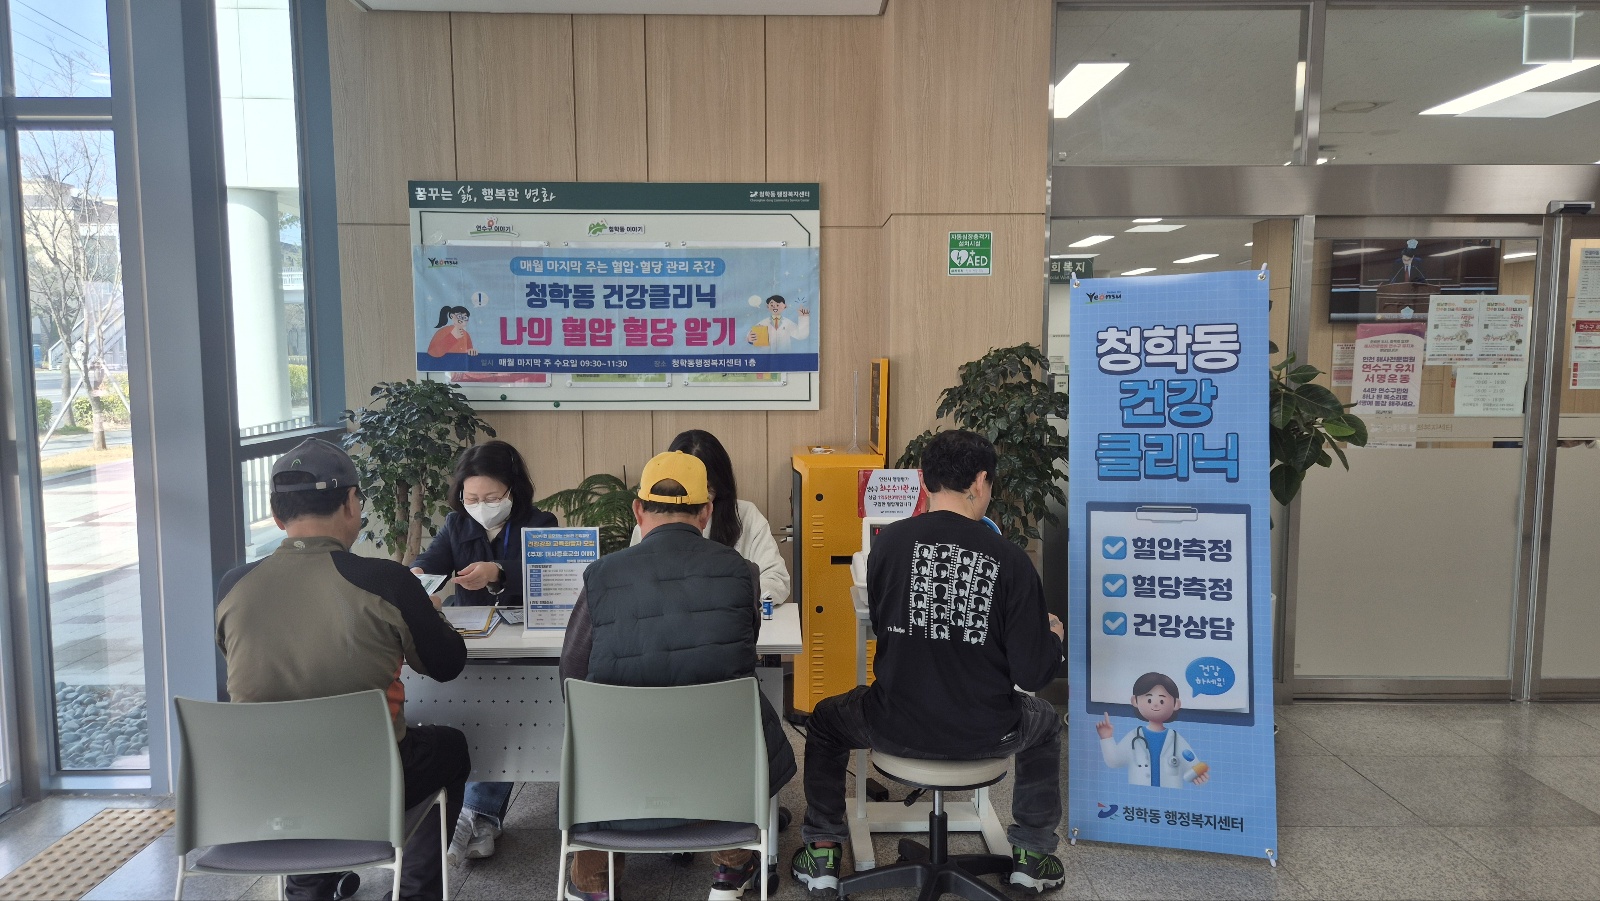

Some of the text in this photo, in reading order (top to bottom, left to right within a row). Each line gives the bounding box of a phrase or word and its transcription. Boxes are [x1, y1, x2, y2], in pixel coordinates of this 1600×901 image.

[415, 185, 557, 203] 꿈꾸는 삶, 행복한 변화
[475, 224, 493, 233] 연수구
[428, 257, 458, 267] Yeonsu
[519, 259, 715, 274] 매월 마지막 주는 혈압·혈당 관리 주간
[966, 255, 988, 267] AED
[1050, 261, 1086, 273] 회복지
[525, 281, 717, 310] 청학동 건강클리닉
[1086, 291, 1122, 303] Yeonsu
[499, 316, 736, 347] 나의 혈압 혈당 알기
[1096, 322, 1241, 375] 청학동
[480, 358, 628, 368] 일시 매월 마지막 주 수요일 09:30~11:30
[654, 359, 757, 368] 장소 청학동행정복지센터 1층
[1361, 363, 1415, 373] 연수구 유치
[1364, 373, 1411, 384] 서명운동
[1119, 377, 1219, 429] 건강
[1095, 432, 1240, 483] 클리닉
[879, 483, 909, 494] 최우수기관
[1131, 536, 1233, 563] 혈압측정
[1131, 574, 1234, 602] 혈당측정
[1132, 613, 1235, 641] 건강상담
[1199, 664, 1222, 677] 건강
[1195, 676, 1226, 687] 하세요!
[1122, 805, 1244, 833] 청학동 행정복지센터
